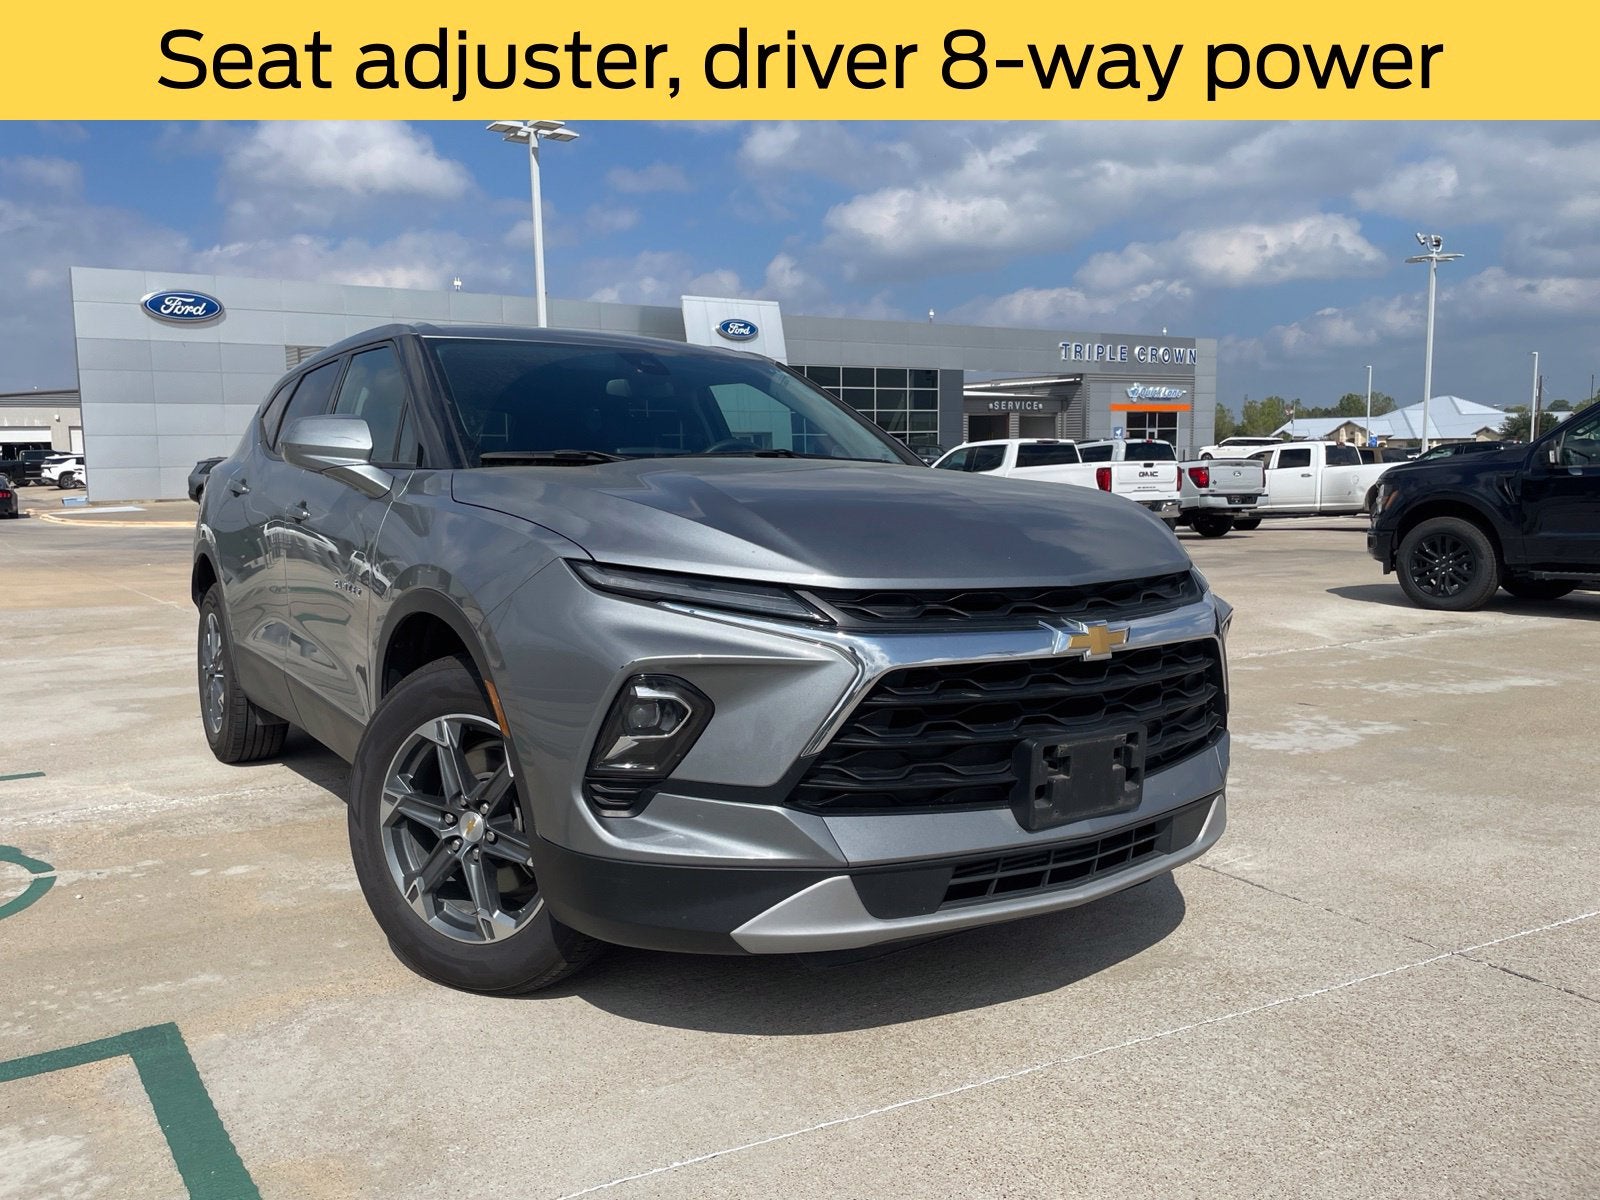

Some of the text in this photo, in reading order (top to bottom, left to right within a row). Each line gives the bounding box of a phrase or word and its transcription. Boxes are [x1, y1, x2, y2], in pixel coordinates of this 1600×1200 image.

[160, 296, 207, 315] Ford
[727, 322, 751, 335] Ford
[1059, 342, 1197, 364] TRIPLE CROWN
[993, 400, 1039, 410] SERVICE
